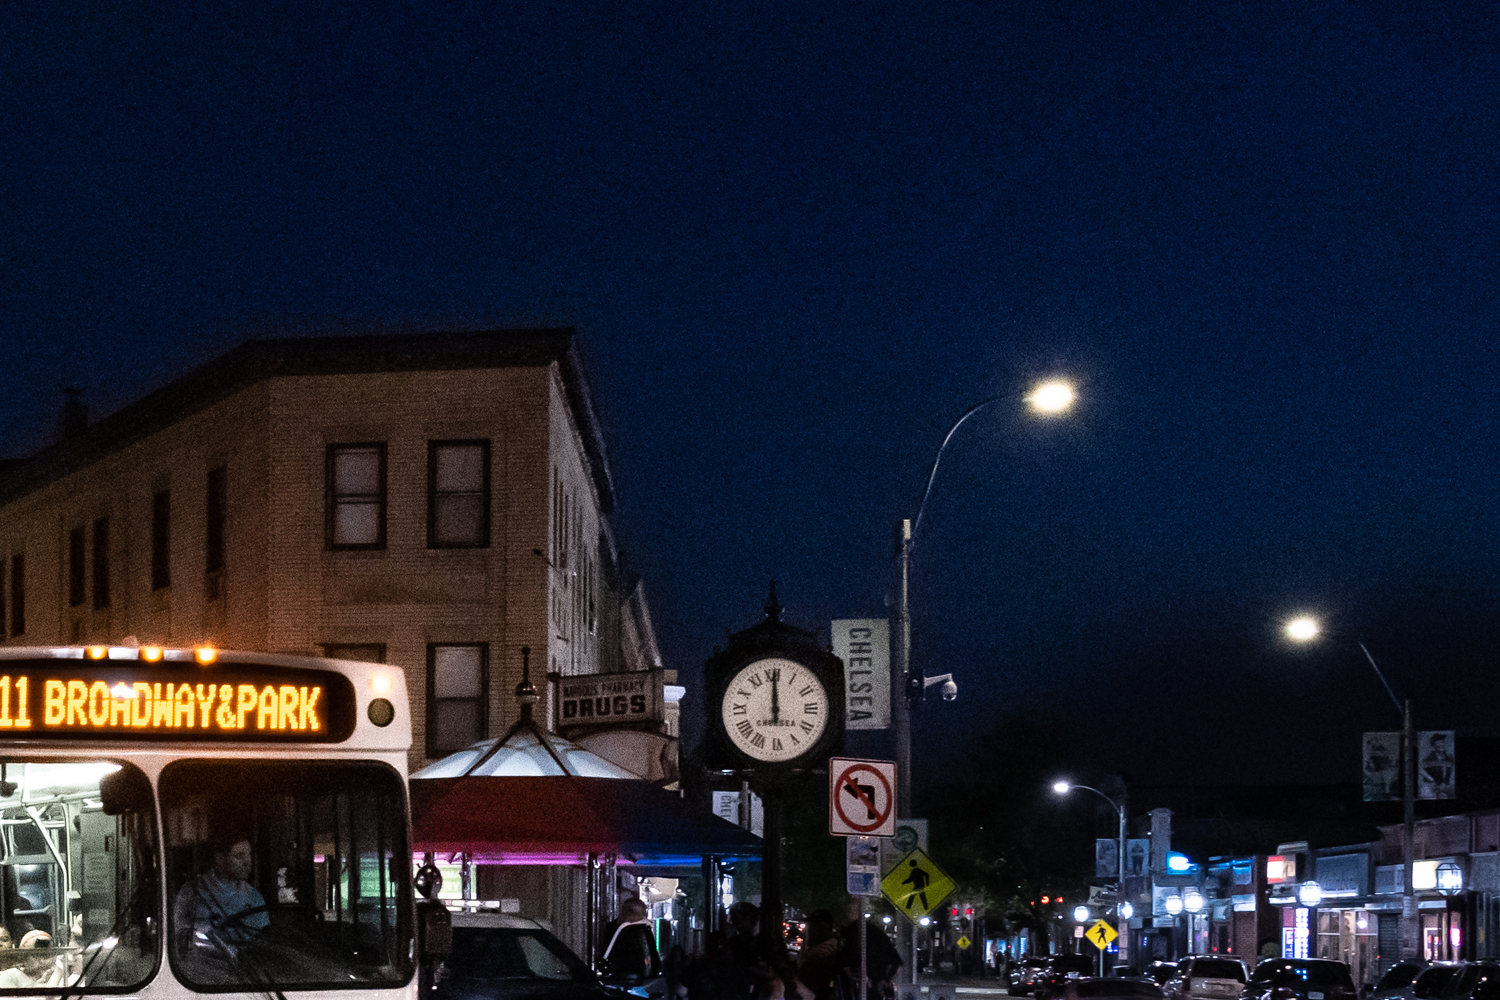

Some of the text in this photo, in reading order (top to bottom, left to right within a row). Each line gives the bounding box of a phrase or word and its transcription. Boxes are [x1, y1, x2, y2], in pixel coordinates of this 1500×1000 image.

[601, 680, 645, 694] PHARMACY
[849, 627, 873, 721] CHELSEA
[45, 680, 321, 729] BROADWAY&PARK
[562, 695, 645, 718] DRUGS
